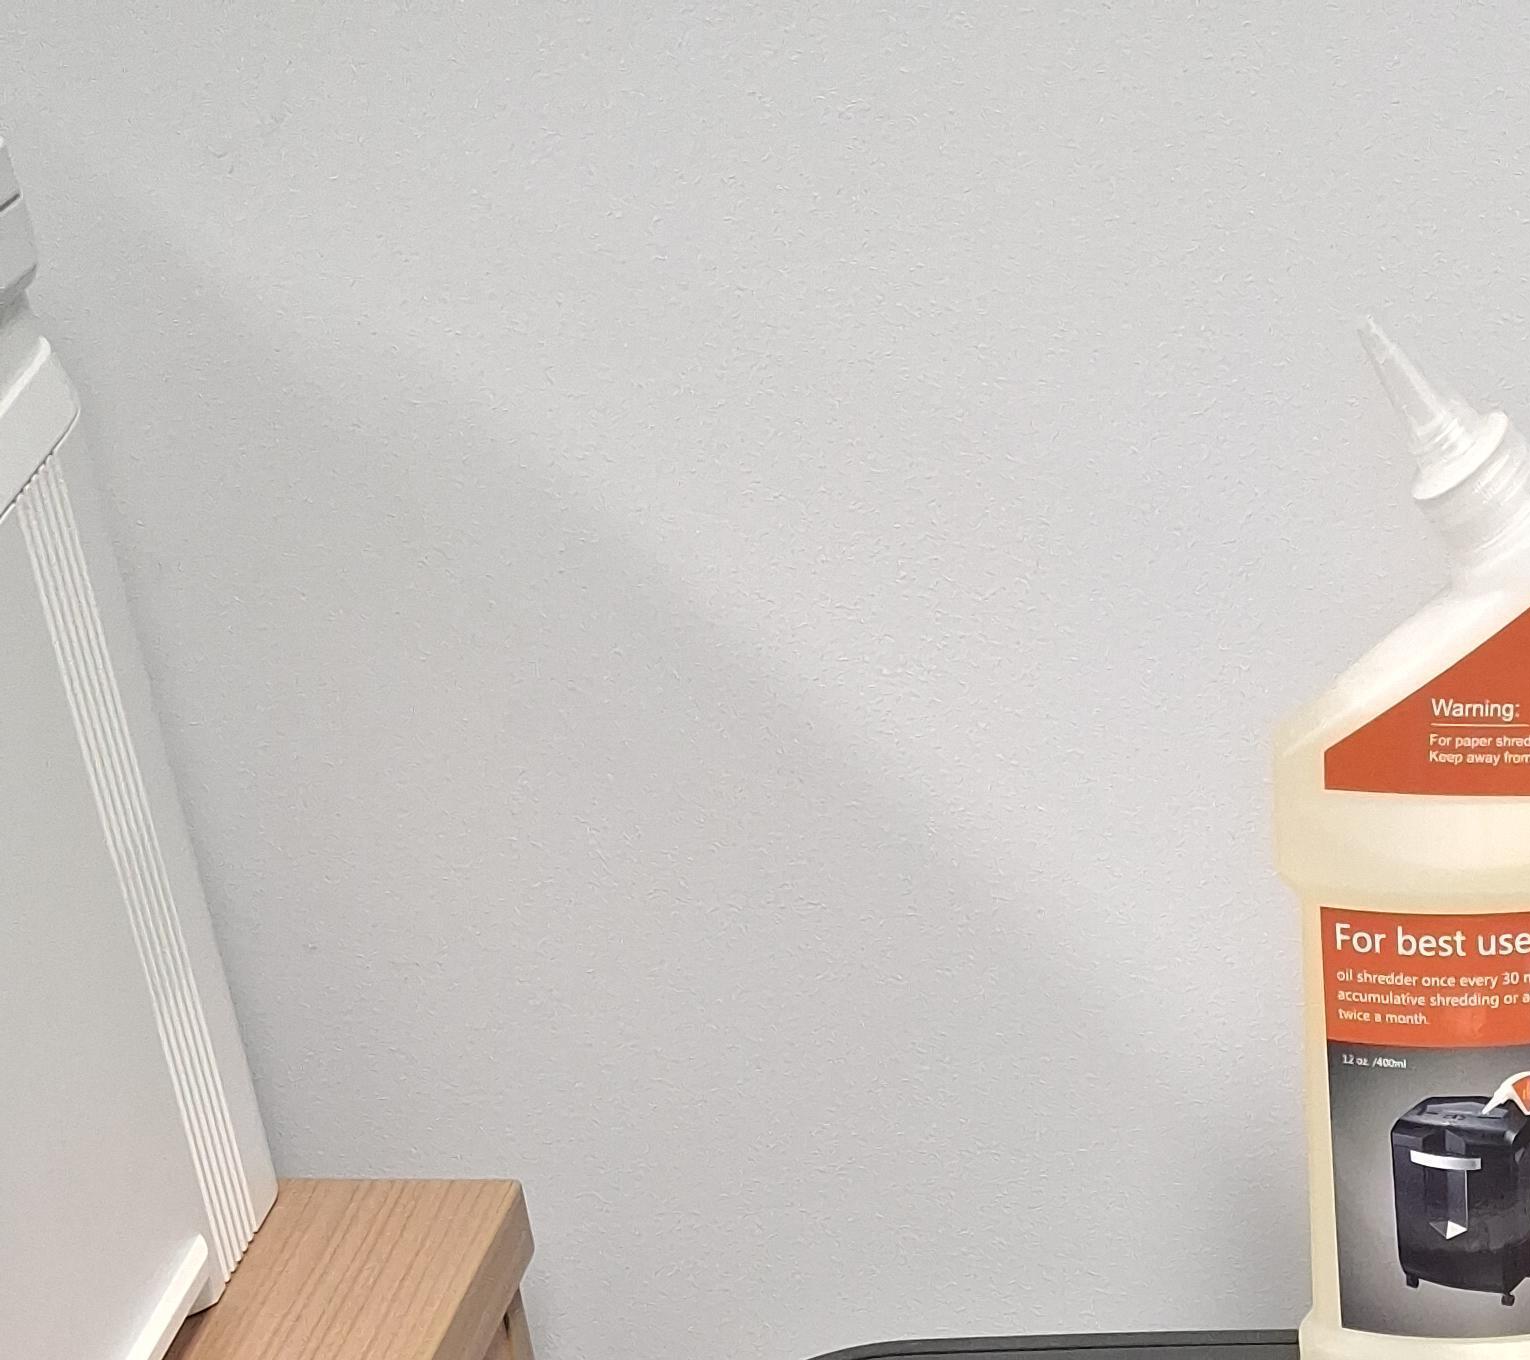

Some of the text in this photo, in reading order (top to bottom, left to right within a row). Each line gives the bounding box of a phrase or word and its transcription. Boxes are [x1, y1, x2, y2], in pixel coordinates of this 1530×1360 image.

[1431, 698, 1520, 722] Warning:
[1429, 734, 1451, 747] For
[1455, 736, 1493, 749] paper
[1429, 751, 1463, 765] Keep
[1467, 754, 1500, 767] away
[1335, 923, 1386, 954] For
[1396, 926, 1466, 957] best
[1336, 969, 1353, 981] oil
[1357, 970, 1418, 987] shredder
[1421, 975, 1456, 987] once
[1459, 973, 1498, 989] every
[1502, 970, 1520, 985] 30
[1337, 989, 1426, 1006] accumulative
[1429, 991, 1500, 1009] shredding
[1503, 993, 1519, 1005] or
[1338, 1009, 1371, 1022] twice
[1374, 1013, 1382, 1022] a
